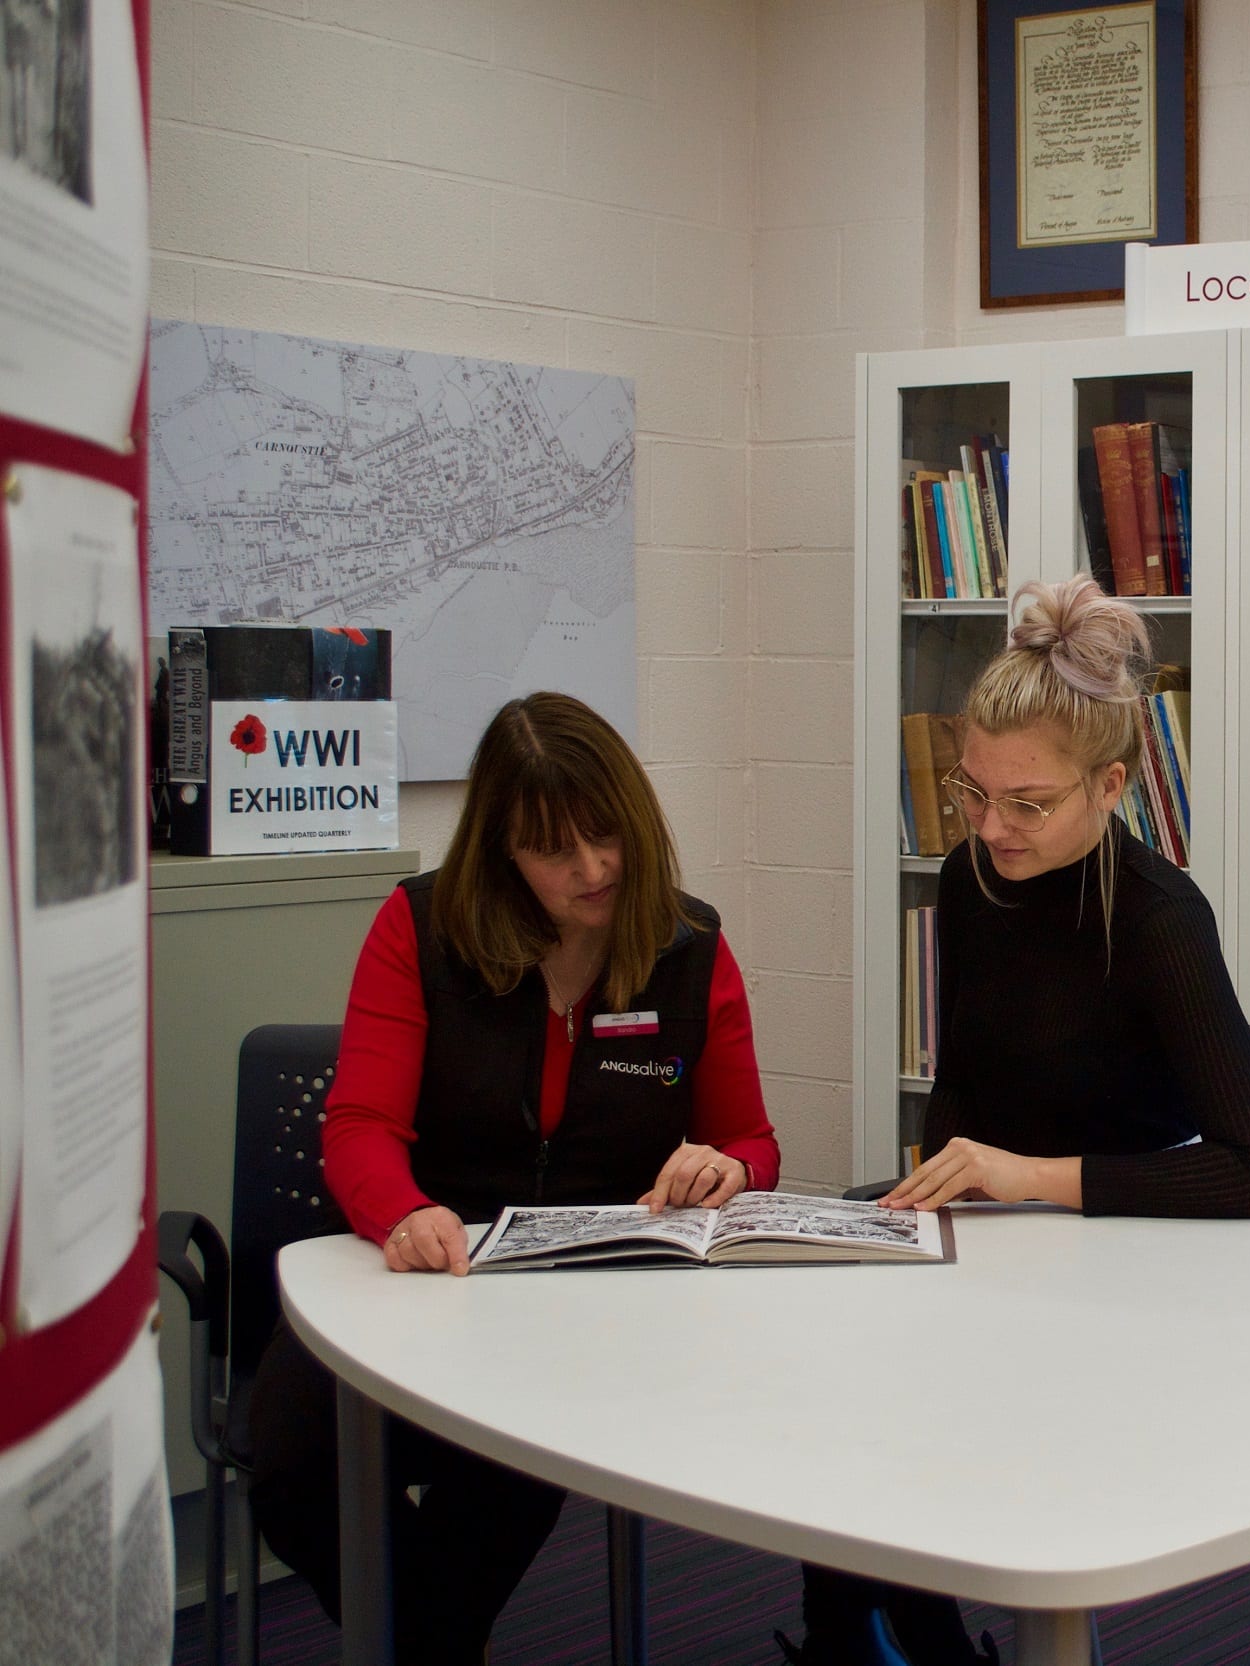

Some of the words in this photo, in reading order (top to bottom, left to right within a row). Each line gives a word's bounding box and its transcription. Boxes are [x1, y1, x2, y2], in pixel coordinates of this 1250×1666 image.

[256, 442, 327, 456] CARNOUSTIE
[173, 667, 186, 695] WAR
[188, 668, 205, 708] Beyond
[173, 702, 186, 744] GREAT
[192, 714, 202, 735] and
[173, 744, 186, 773] THE
[189, 740, 204, 774] Angus
[273, 729, 360, 768] WWI
[230, 784, 379, 813] EXHIBITION
